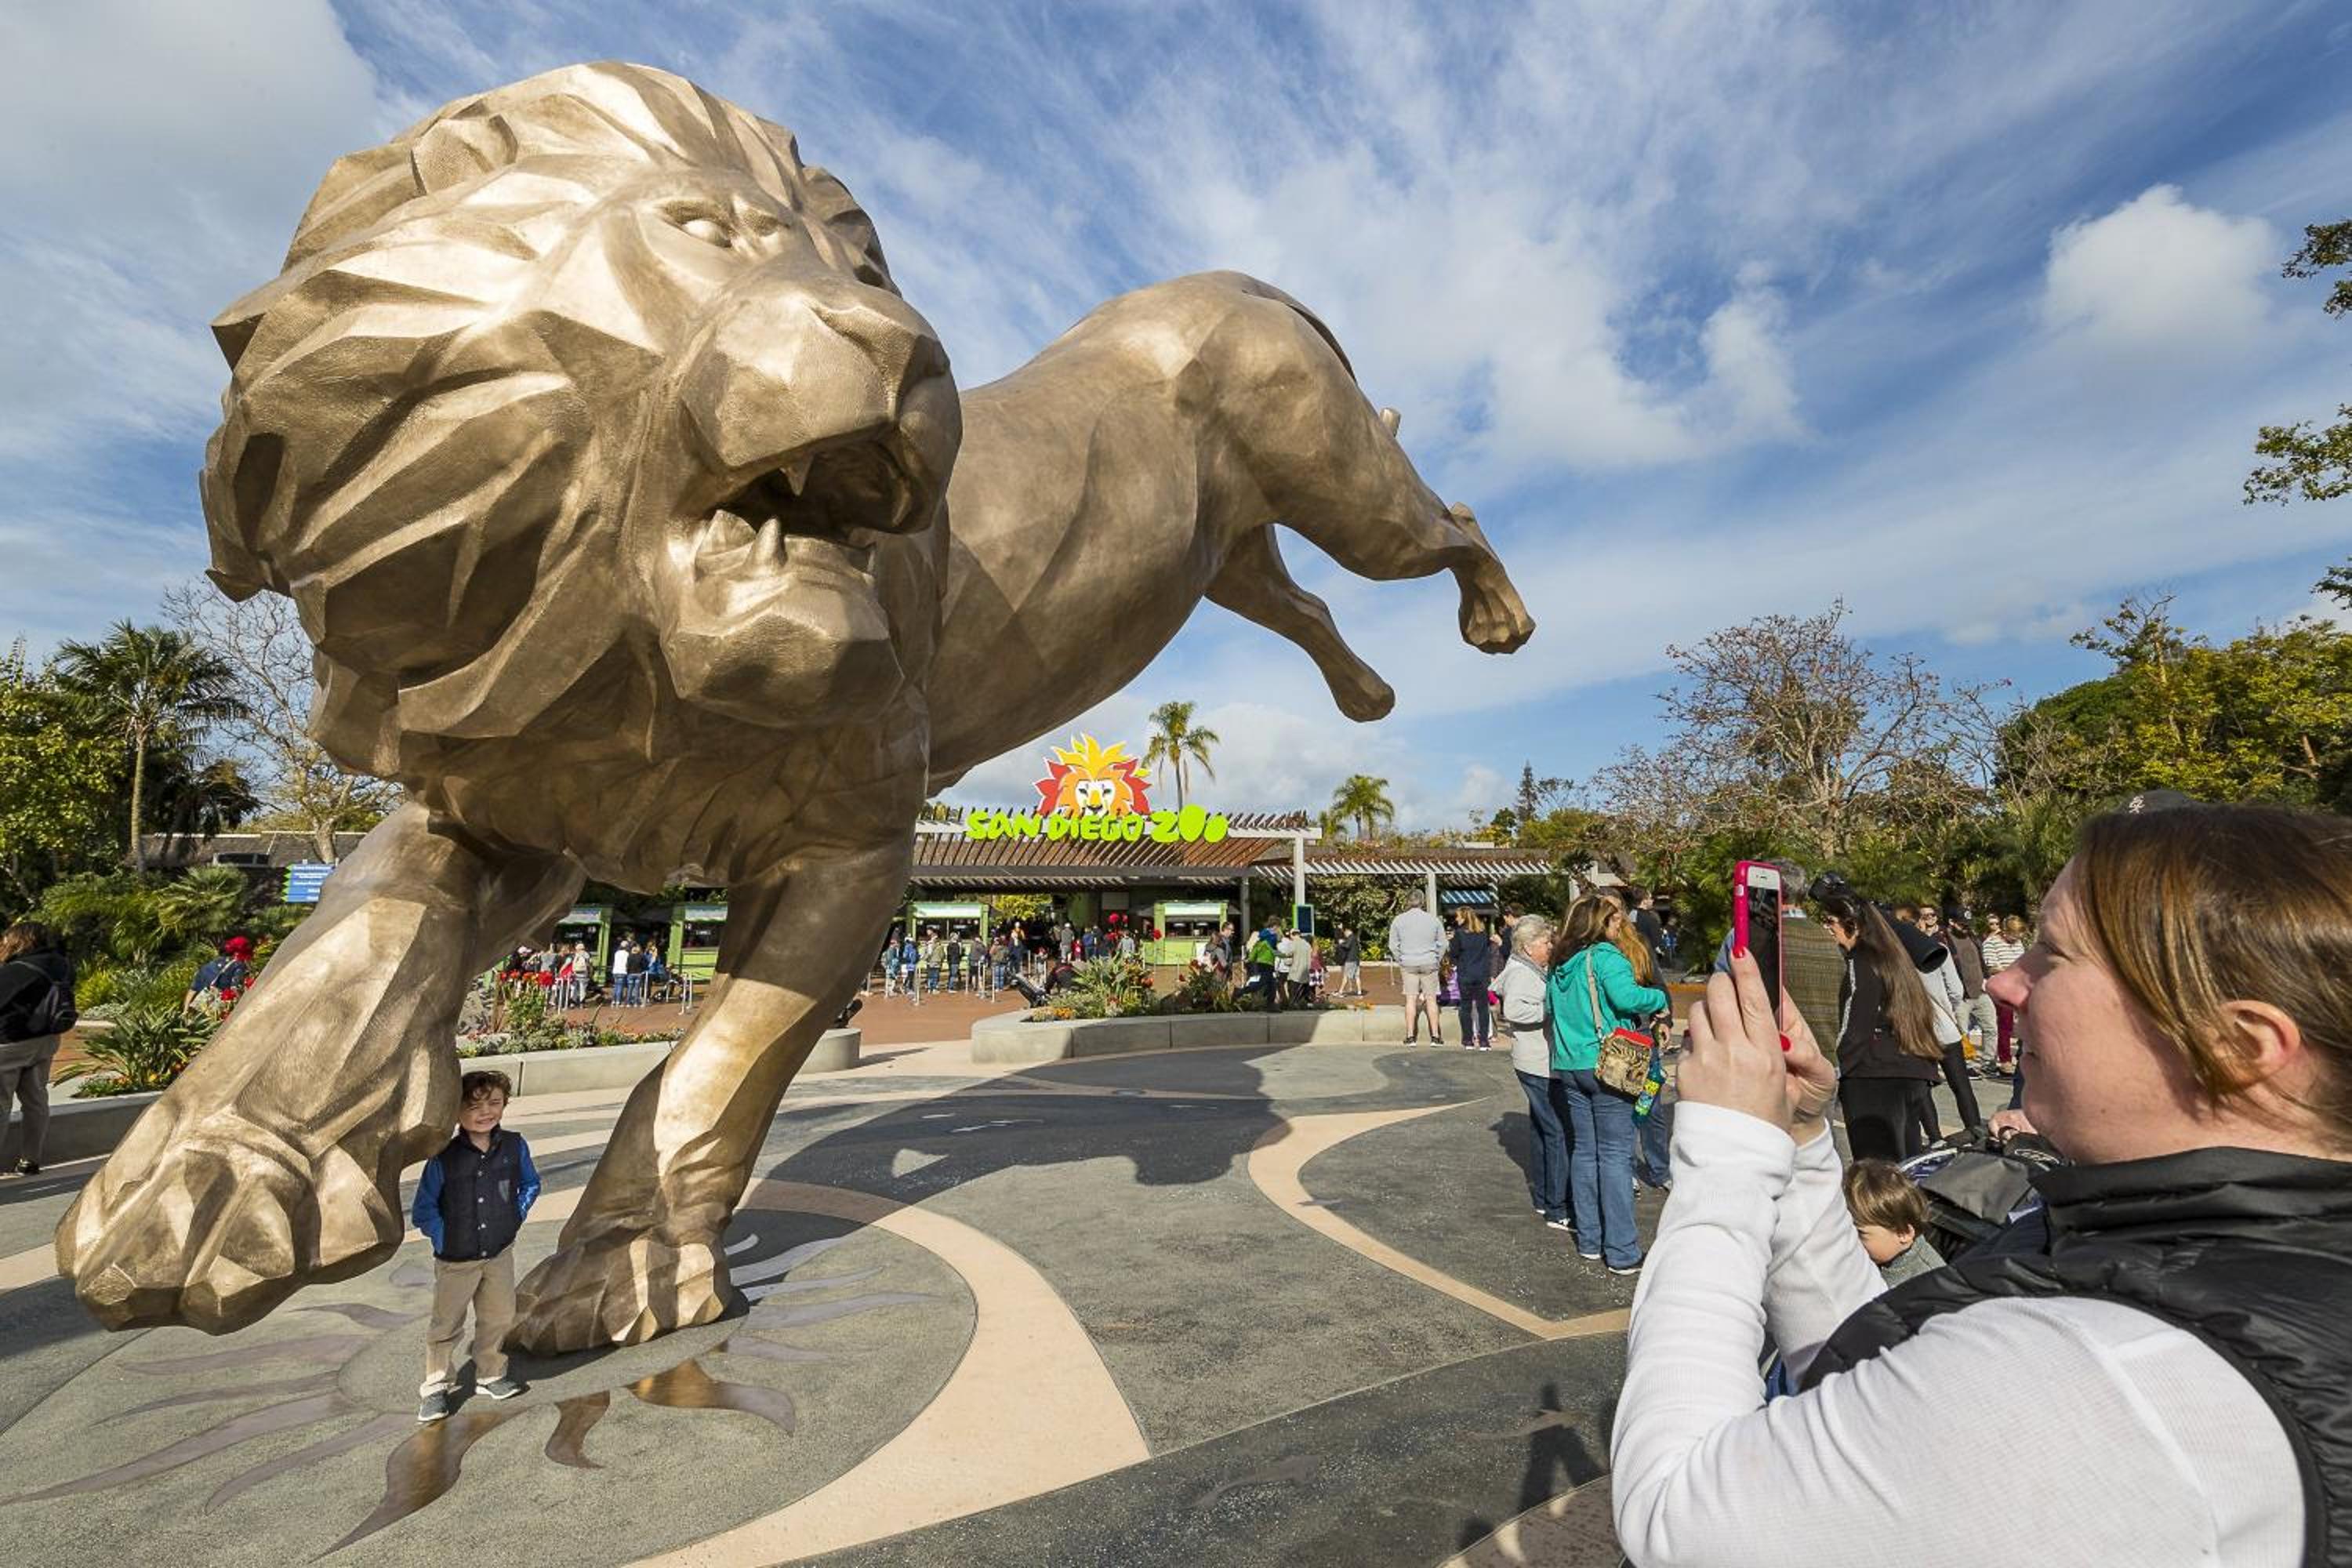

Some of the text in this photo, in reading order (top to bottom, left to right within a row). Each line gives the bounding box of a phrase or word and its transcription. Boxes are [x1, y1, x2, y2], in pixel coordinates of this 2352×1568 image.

[967, 804, 1229, 843] SAN DIEGO ZOO
